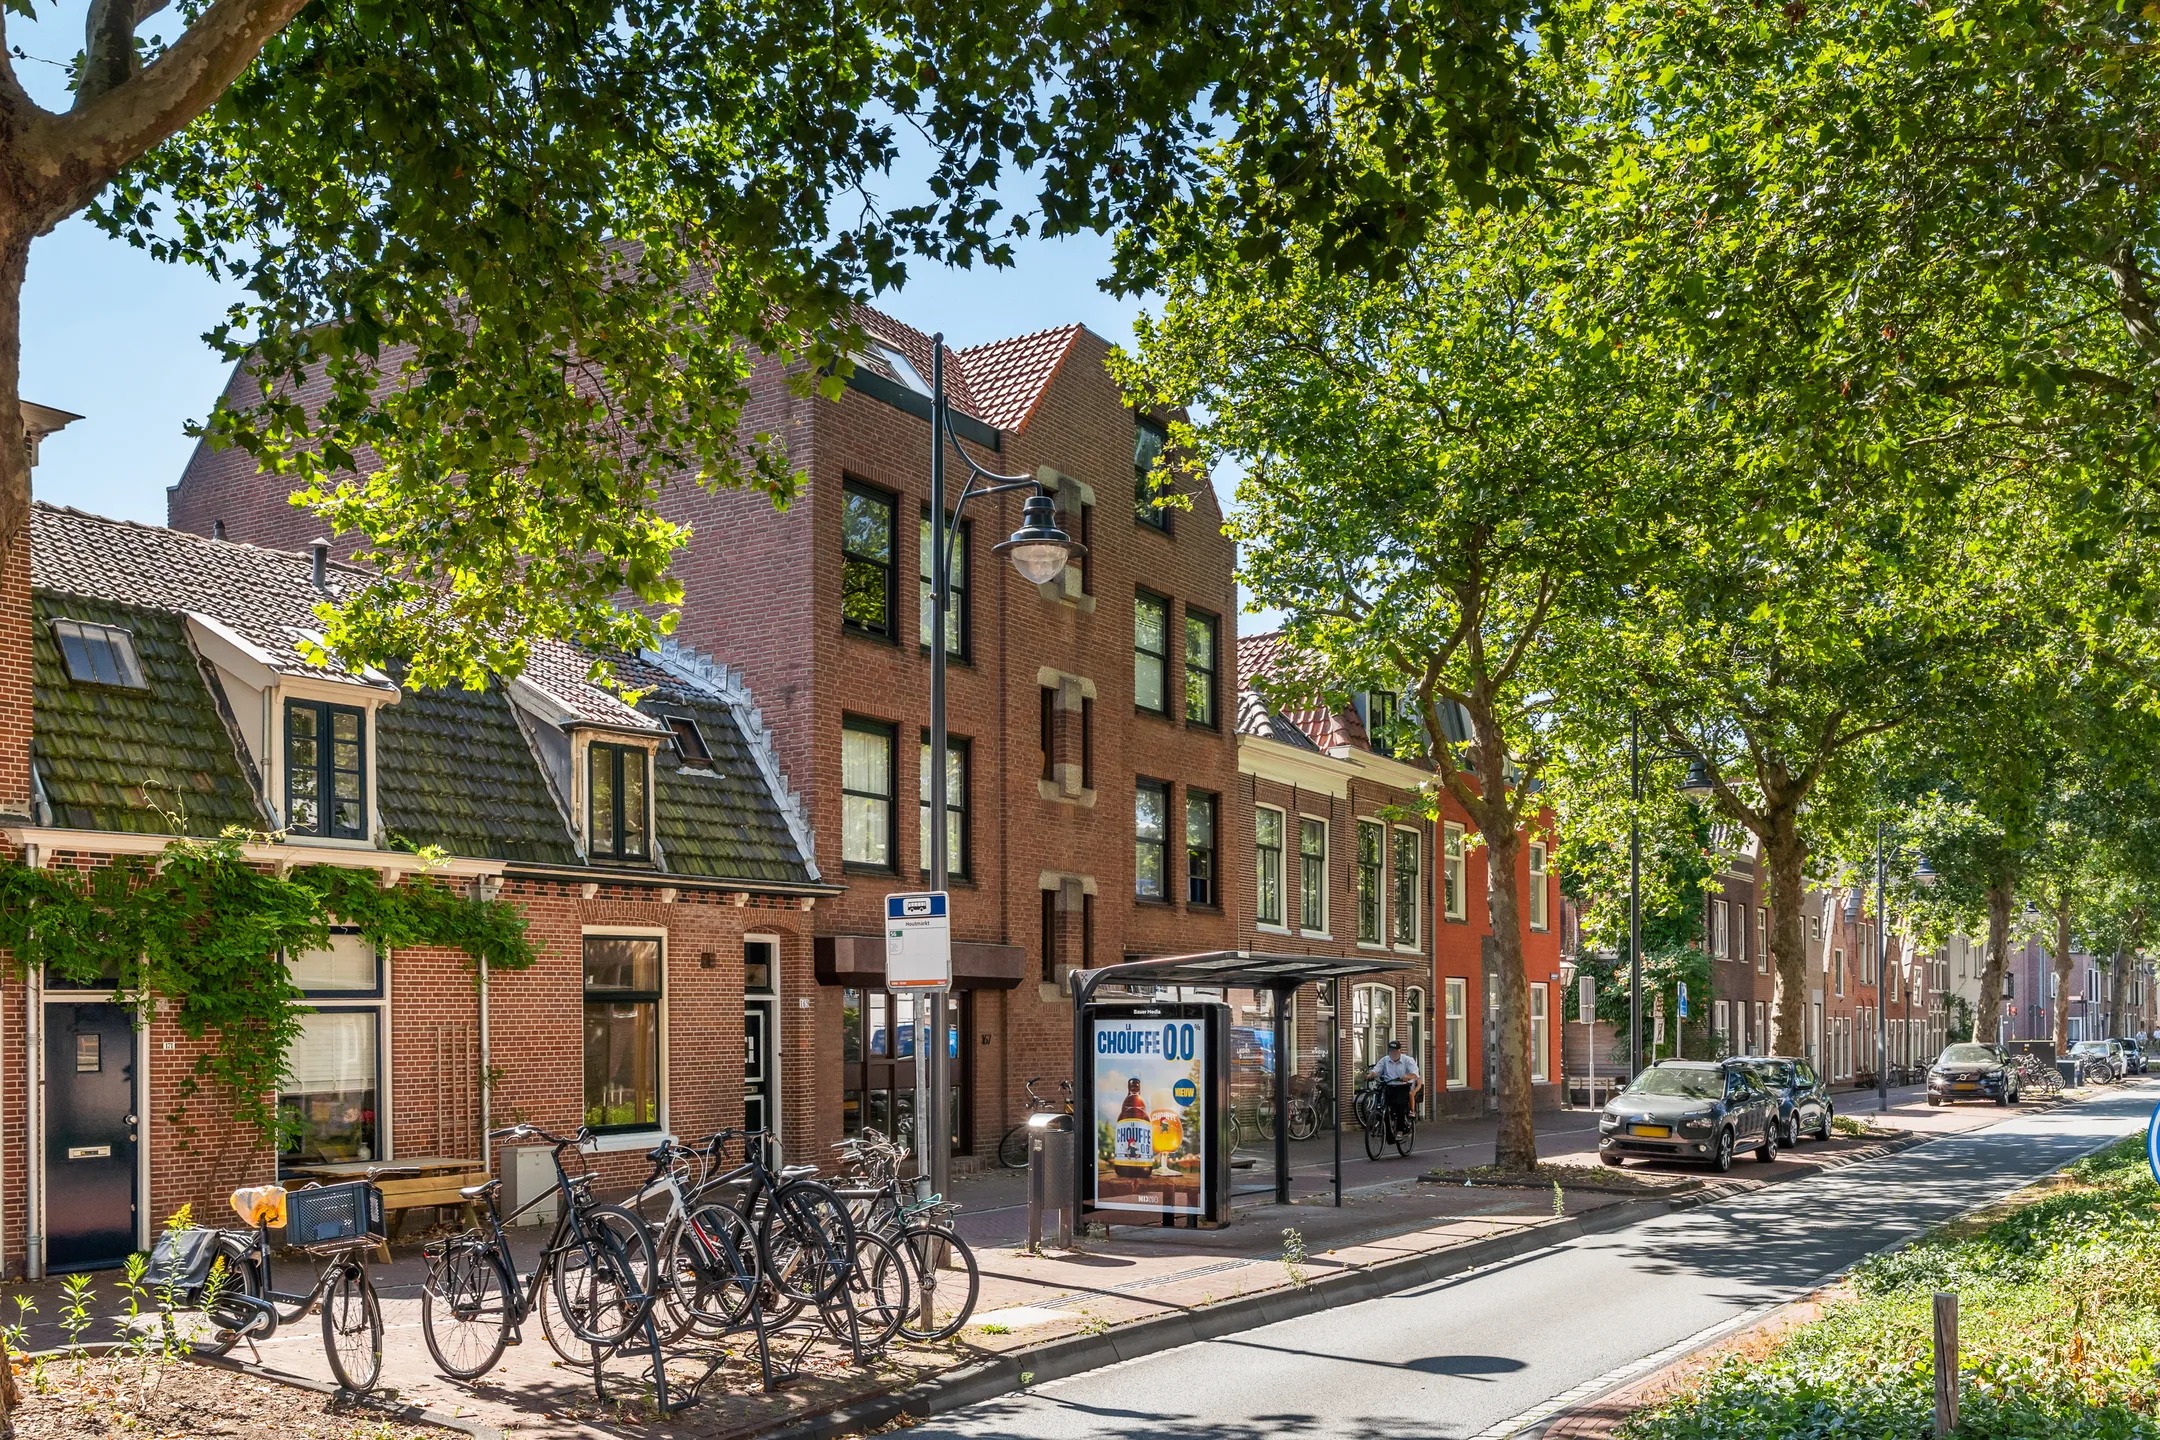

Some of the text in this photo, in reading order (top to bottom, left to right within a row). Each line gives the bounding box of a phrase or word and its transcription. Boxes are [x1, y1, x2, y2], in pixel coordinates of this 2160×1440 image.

[1126, 1023, 1131, 1031] LA
[1097, 1030, 1160, 1054] CHOUFFE
[1174, 1087, 1195, 1098] NIEUW
[1116, 1126, 1152, 1145] CHOUFFE
